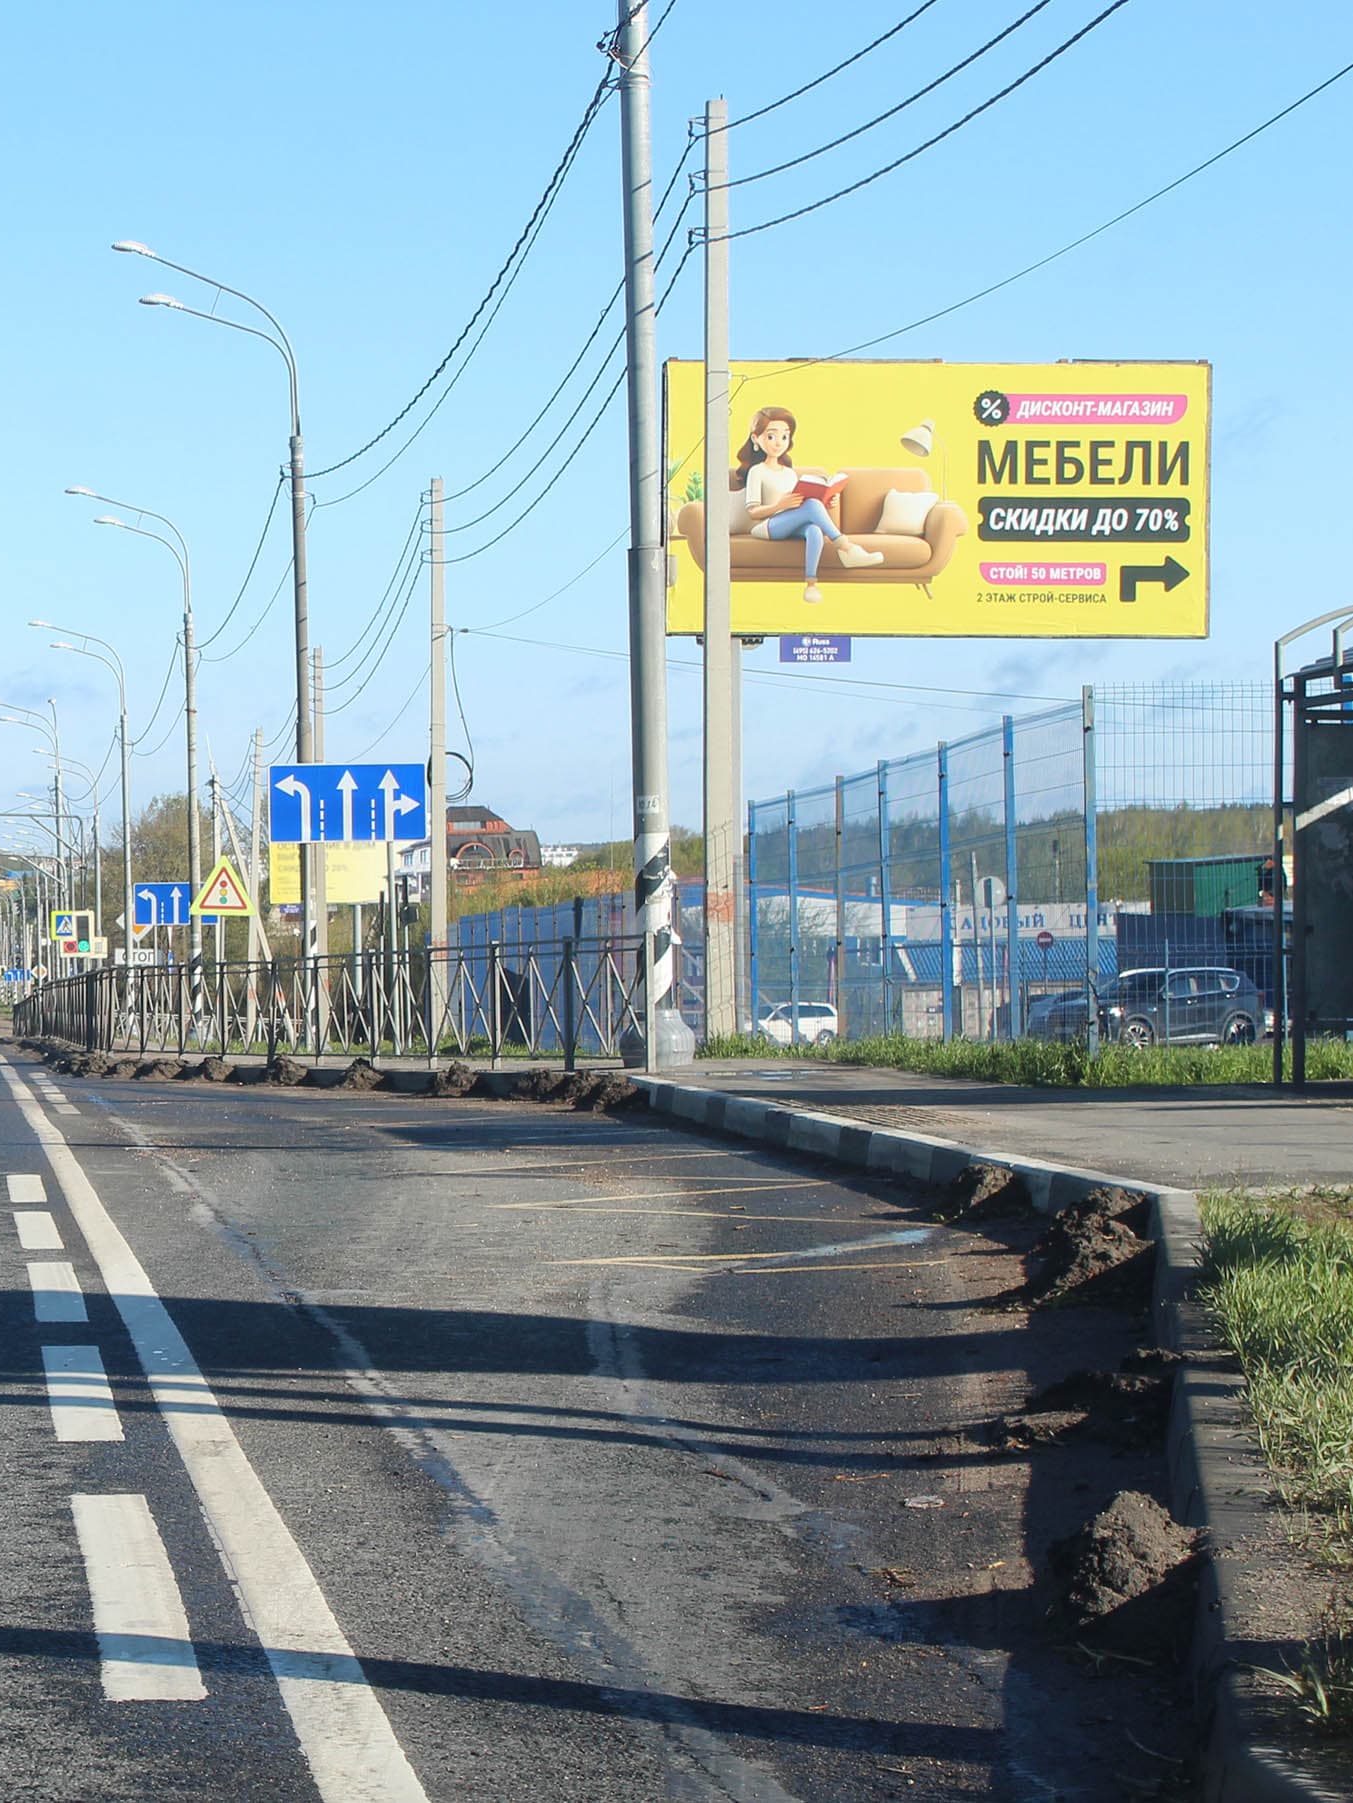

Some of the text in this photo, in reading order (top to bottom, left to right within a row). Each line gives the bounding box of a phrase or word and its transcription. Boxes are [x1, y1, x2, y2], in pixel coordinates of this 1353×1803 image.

[1016, 400, 1174, 418] ДИСКОНТ-МАГАЗИН
[977, 440, 1189, 485] МЕБЕЛИ
[989, 508, 1179, 536] СКИДКИ ДО 70%
[989, 565, 1102, 580] СТОЙ! 50 МЕТРОВ
[976, 591, 1107, 604] 2 ЭТАЖ СТРОЙ-СЕРВИСА
